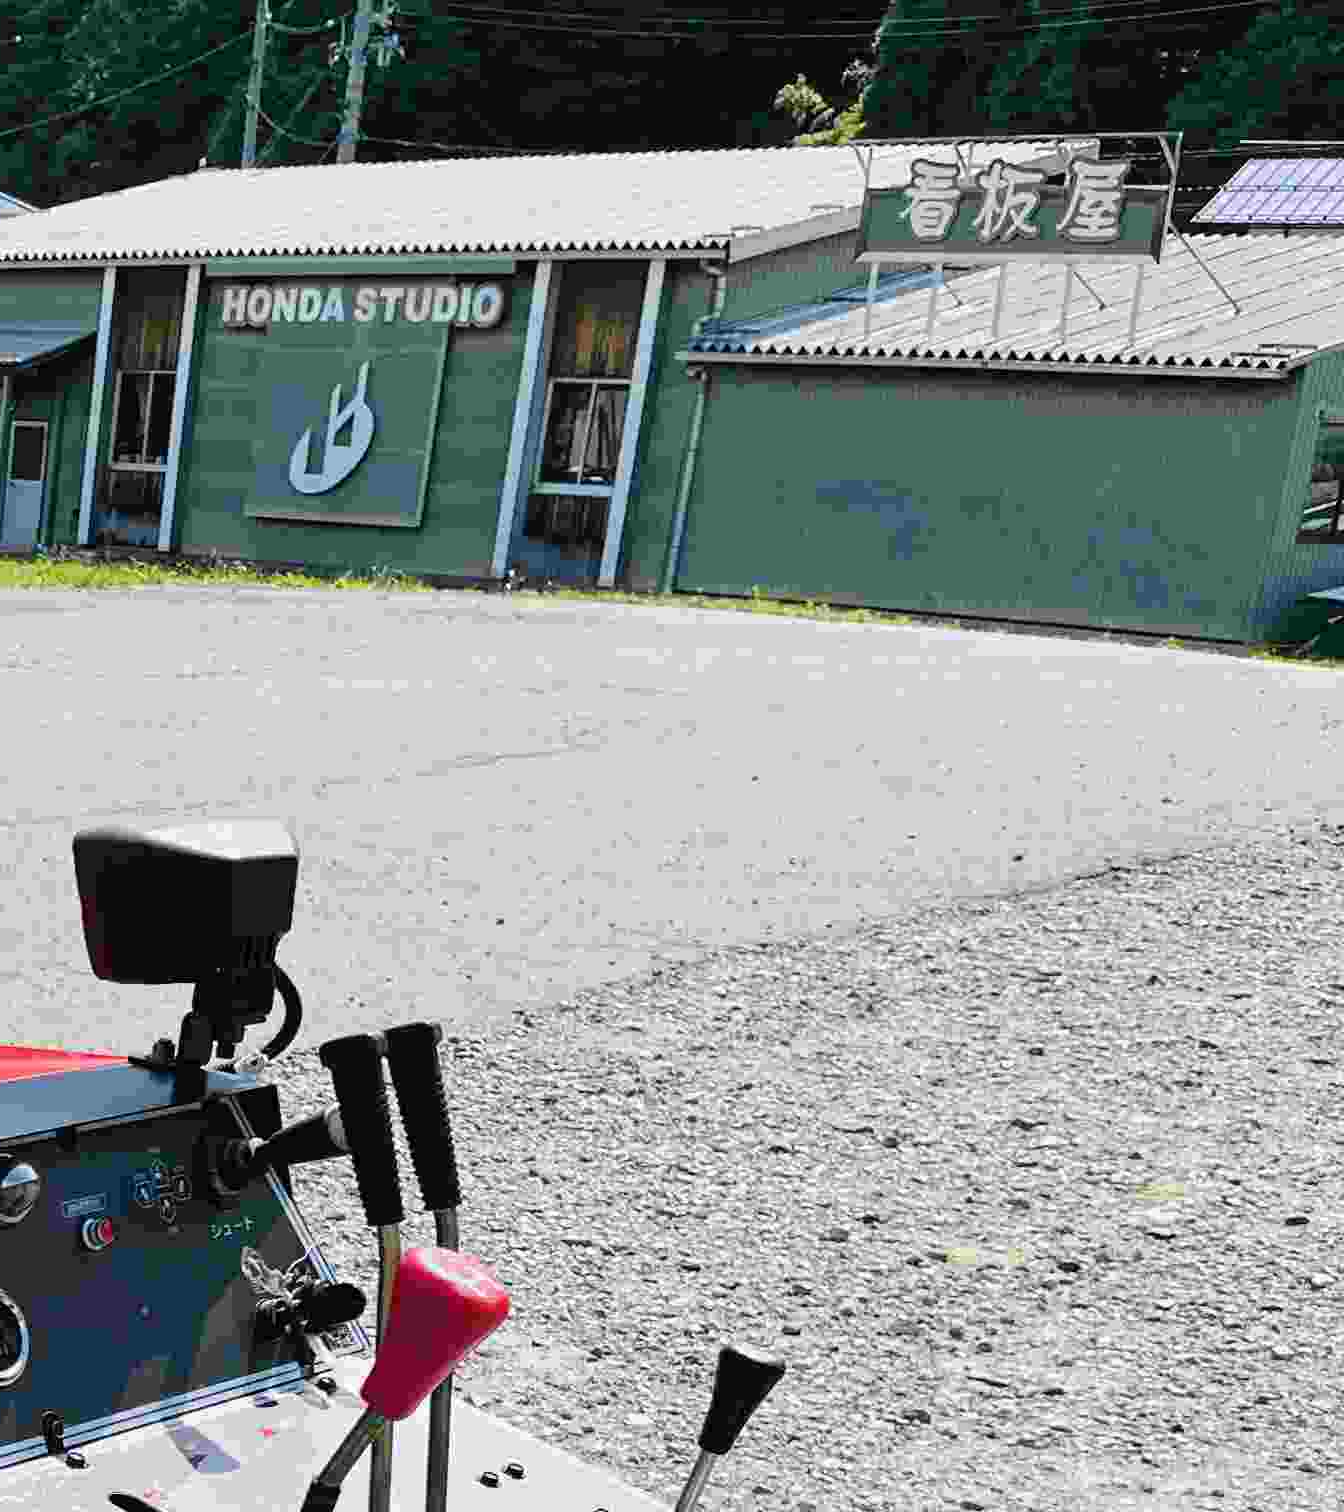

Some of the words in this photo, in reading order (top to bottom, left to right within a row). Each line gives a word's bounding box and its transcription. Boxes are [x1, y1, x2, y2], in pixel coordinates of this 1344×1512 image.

[896, 160, 1128, 241] 看板屋
[222, 285, 348, 323] HONDA
[353, 284, 503, 326] STUDIO
